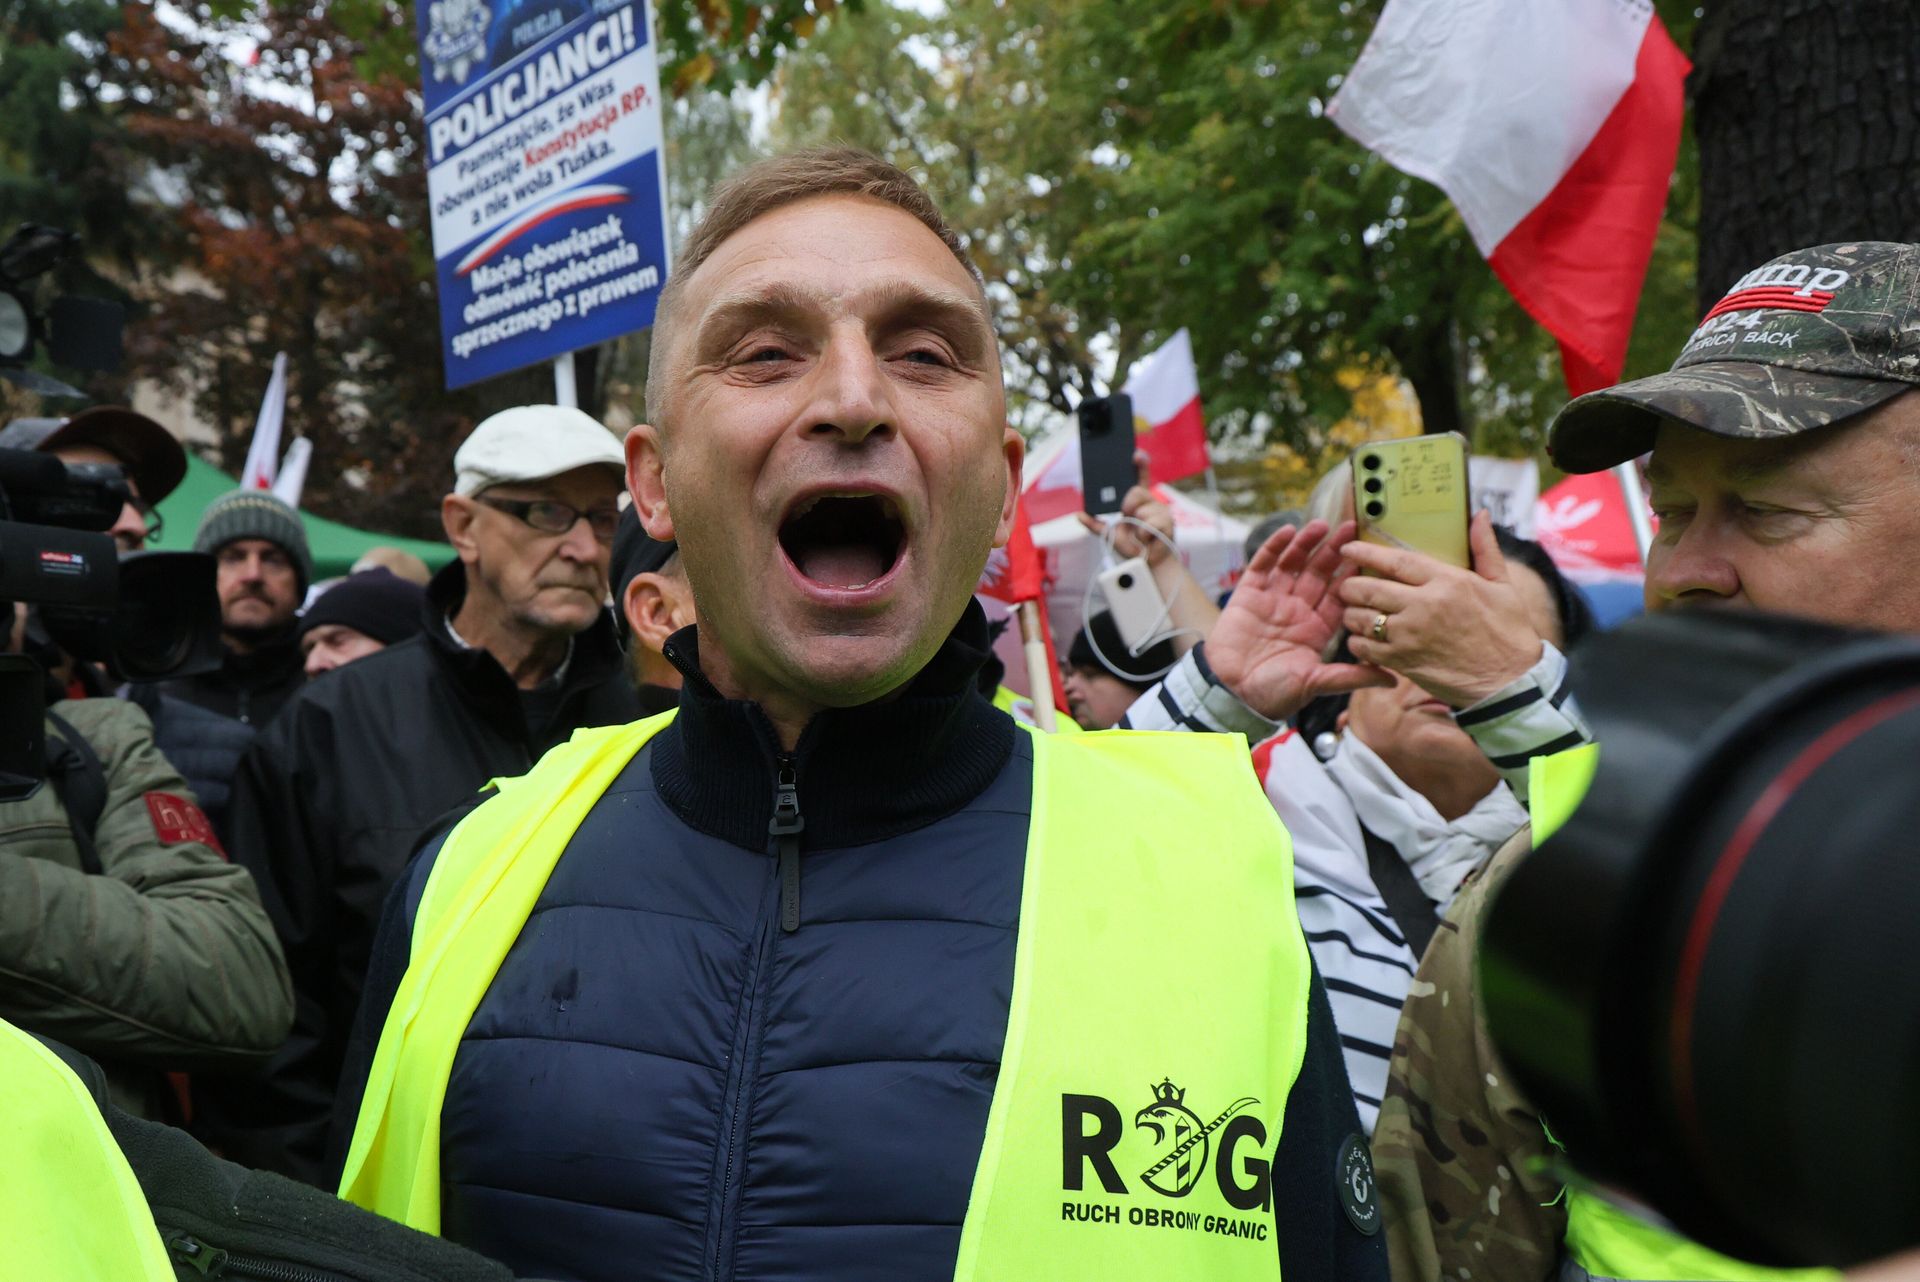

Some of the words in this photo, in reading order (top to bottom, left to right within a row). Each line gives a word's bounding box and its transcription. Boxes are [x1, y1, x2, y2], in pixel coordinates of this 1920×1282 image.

[429, 4, 636, 163] POLICJANCI!
[524, 104, 618, 169] Konstytucja
[620, 83, 653, 115] RP,
[577, 79, 615, 108] Was
[470, 208, 480, 225] a
[484, 191, 509, 217] nie
[513, 170, 554, 202] wola
[556, 140, 616, 179] Tuska.
[463, 270, 544, 325] odmówić
[544, 240, 640, 299] polecenia
[470, 255, 523, 294] Macie
[523, 213, 624, 275] obowiązek
[451, 298, 564, 359] sprzecznego
[564, 293, 577, 316] z
[577, 265, 659, 318] prawem
[1742, 331, 1799, 348] BACK
[1062, 1202, 1120, 1224] RUCH
[1128, 1207, 1201, 1231] OBRONY
[1204, 1215, 1268, 1241] GRANIC
